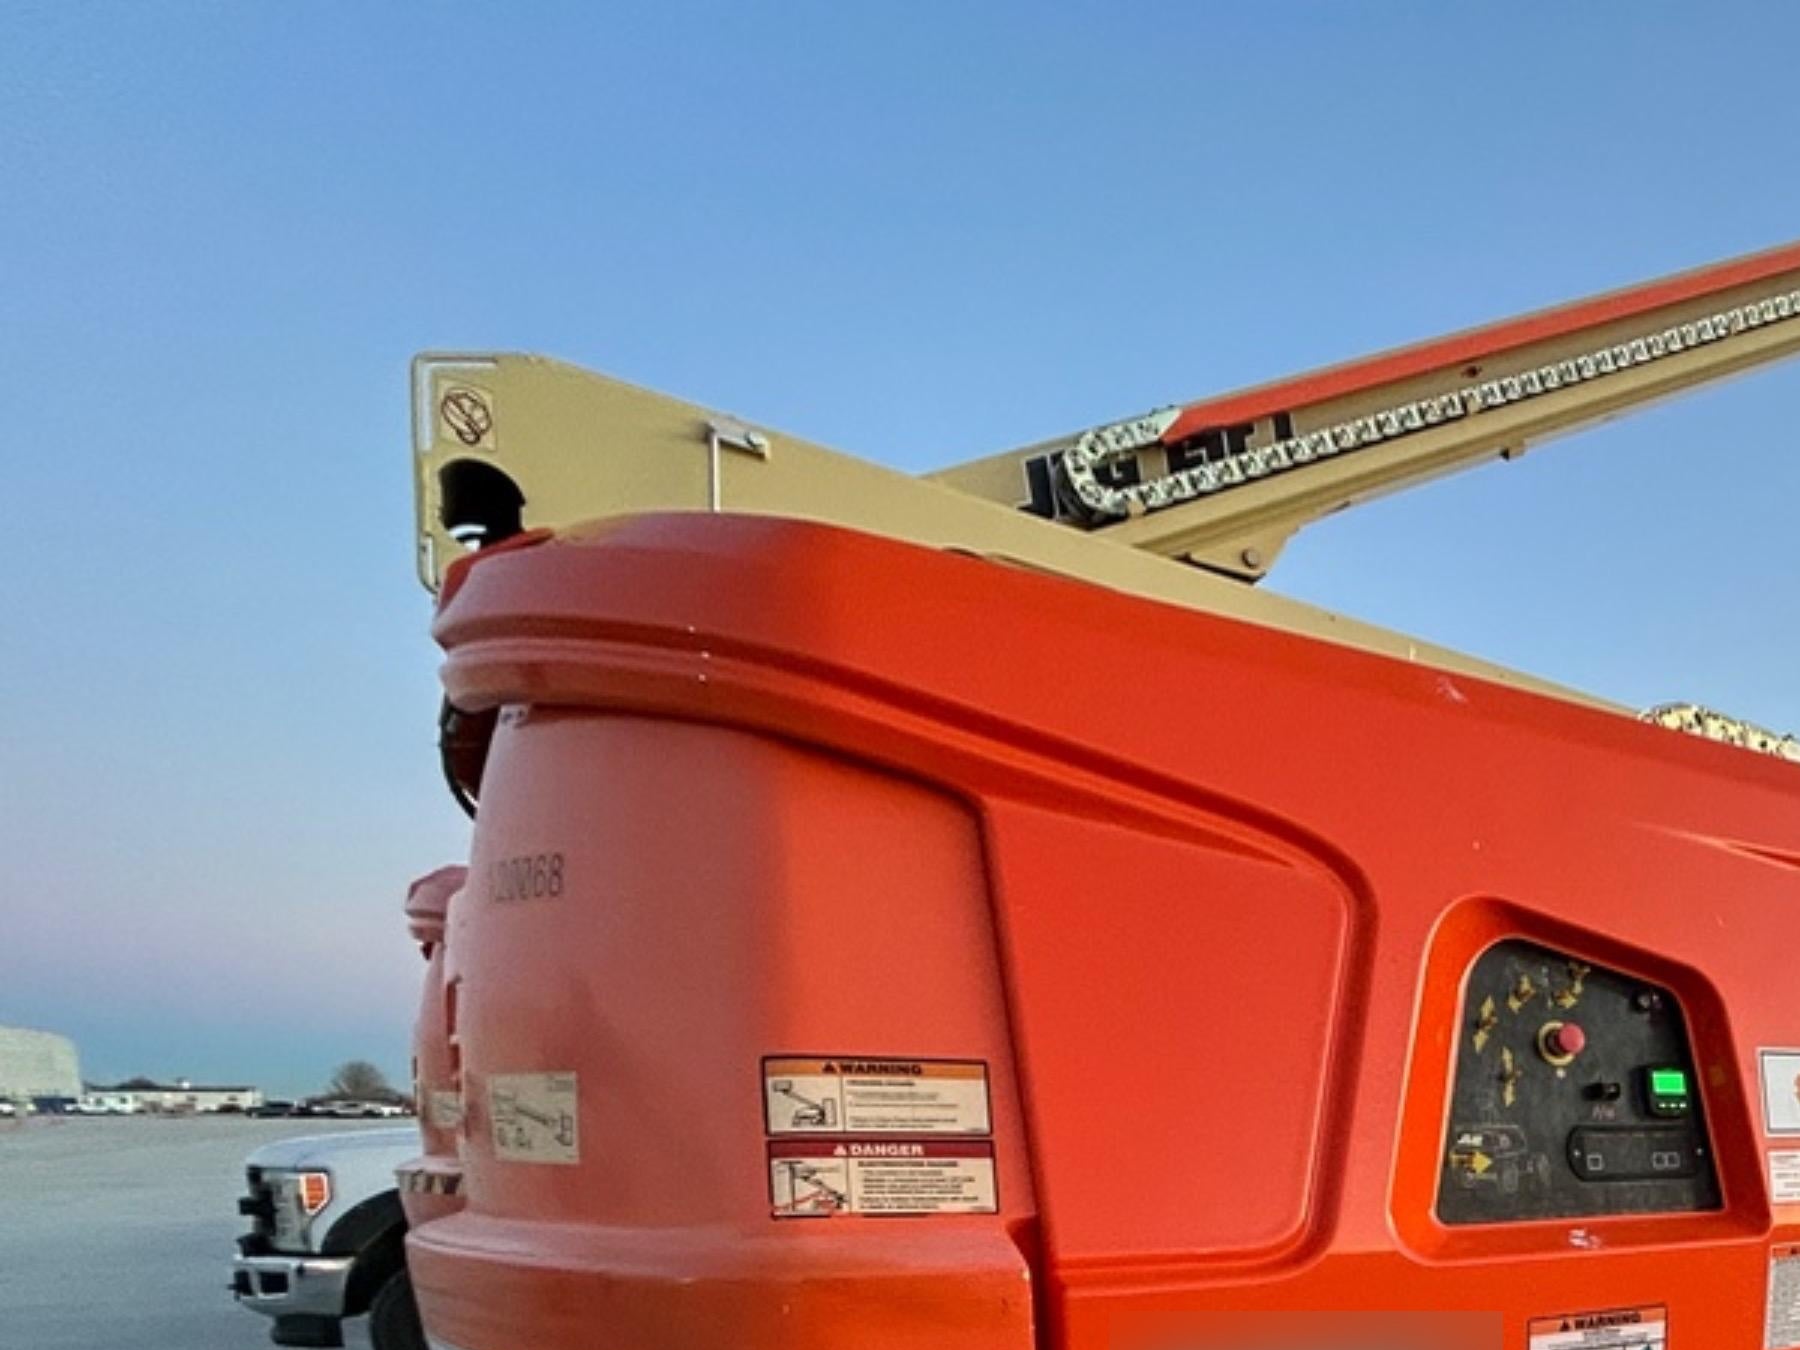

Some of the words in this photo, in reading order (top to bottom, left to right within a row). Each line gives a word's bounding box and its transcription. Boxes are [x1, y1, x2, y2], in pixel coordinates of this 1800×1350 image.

[839, 1062, 923, 1075] WARNING
[850, 1144, 924, 1156] DANGER
[1574, 1312, 1642, 1330] WARNING
